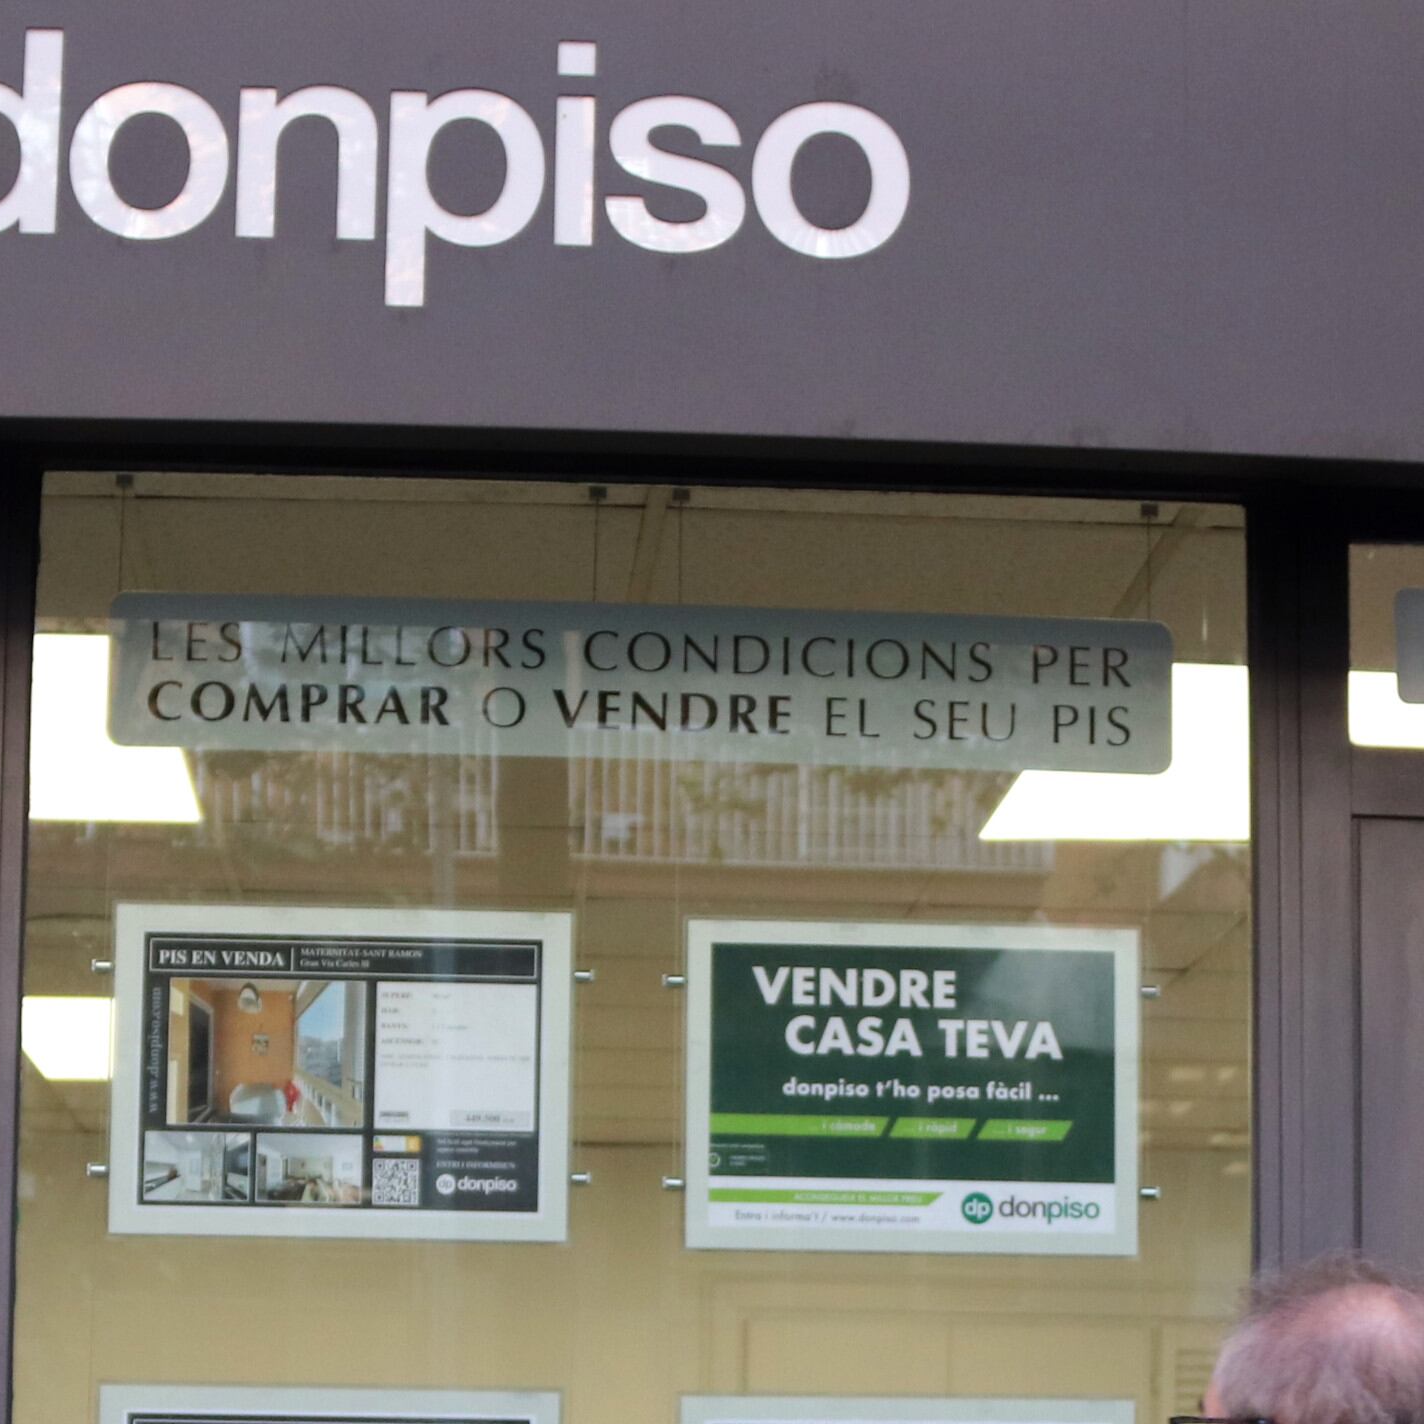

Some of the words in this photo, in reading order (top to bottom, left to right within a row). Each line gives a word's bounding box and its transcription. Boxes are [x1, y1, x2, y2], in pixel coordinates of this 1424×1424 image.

[151, 620, 244, 664] LES
[280, 623, 547, 669] MILLORS
[583, 628, 994, 681] CONDICIONS
[1031, 644, 1132, 688] PER
[147, 680, 450, 726] COMPRAR
[481, 686, 526, 729] O
[554, 690, 791, 736] VENDRE
[824, 696, 880, 738] EL
[910, 698, 1016, 741] SEU
[1052, 702, 1132, 746] PIS
[158, 949, 186, 965] PIS
[191, 950, 216, 966] EN
[221, 950, 284, 967] VENDA
[752, 966, 956, 1009] VENDRE
[149, 987, 162, 1113] www.donpiso.com
[785, 1016, 922, 1057] CASA
[939, 1019, 1063, 1060] TEVA
[782, 1077, 869, 1102] donpiso
[877, 1079, 920, 1098] t'ho
[928, 1084, 979, 1102] posa
[987, 1081, 1032, 1100] fàcil
[457, 1174, 518, 1195] donpiso
[999, 1196, 1100, 1225] donpiso
